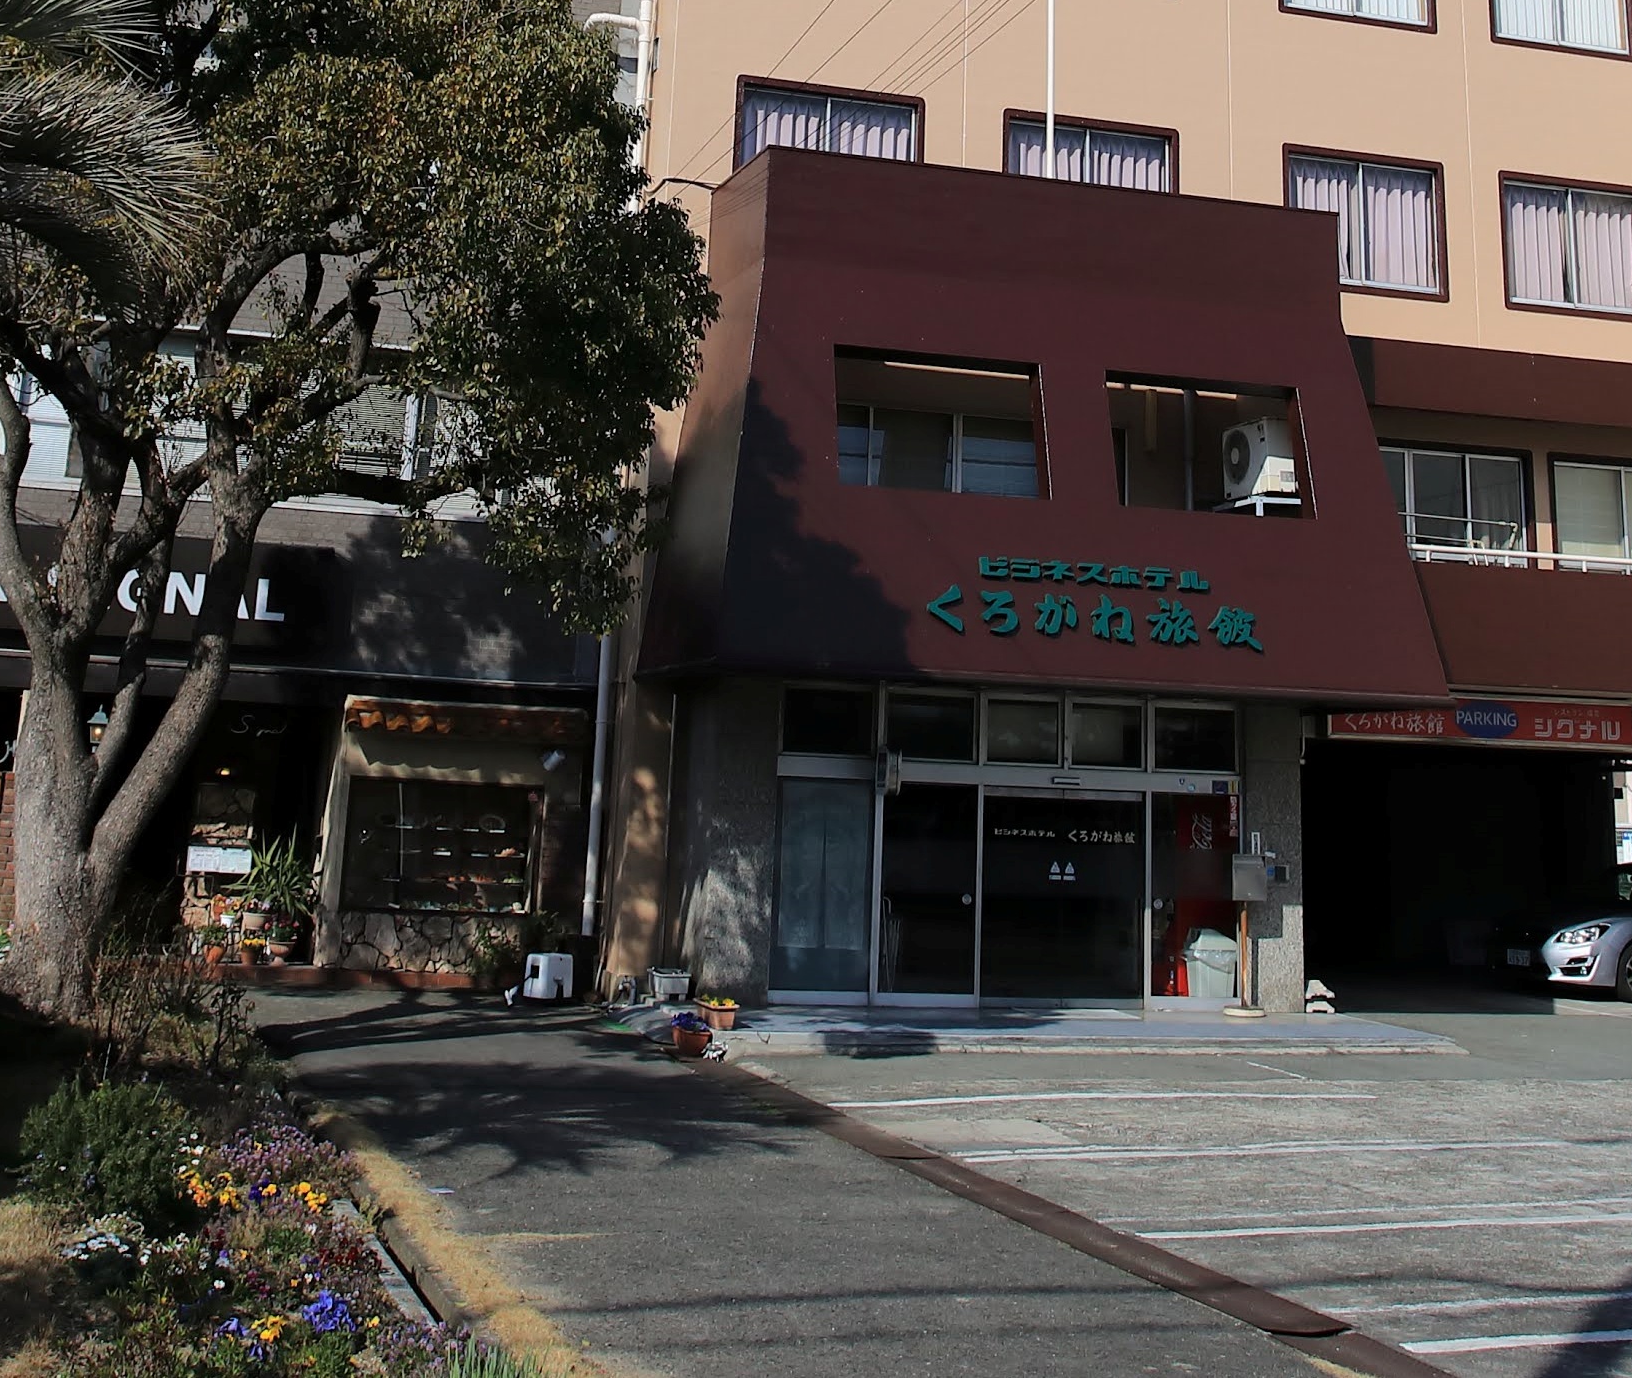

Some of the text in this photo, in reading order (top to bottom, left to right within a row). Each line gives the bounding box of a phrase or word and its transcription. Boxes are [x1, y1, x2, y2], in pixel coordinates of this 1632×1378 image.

[977, 555, 1211, 592] ビジネスホテル
[926, 583, 1265, 653] くろがね旅館
[1344, 711, 1446, 736] くろがね旅館
[1455, 709, 1518, 729] PARKING
